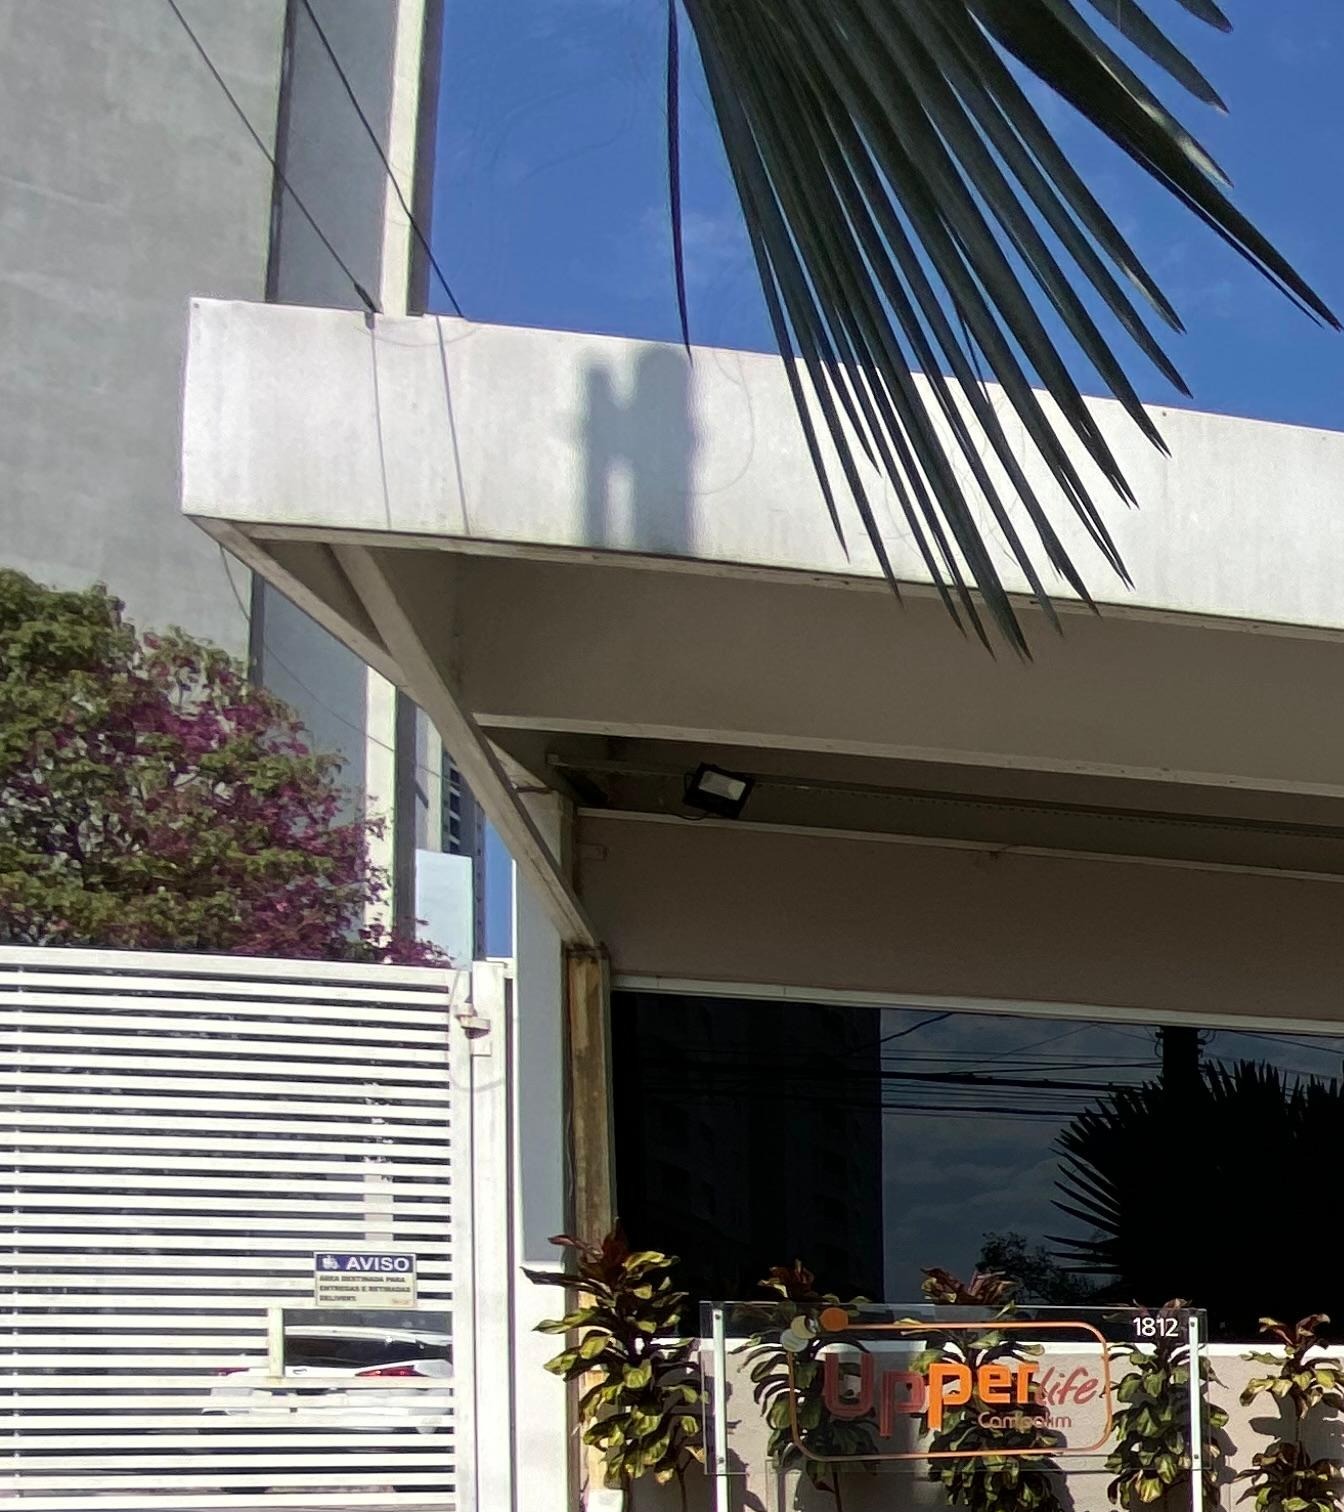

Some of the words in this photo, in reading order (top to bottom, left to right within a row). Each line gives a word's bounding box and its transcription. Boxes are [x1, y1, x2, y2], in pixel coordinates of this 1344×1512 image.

[346, 1256, 410, 1271] AVISO
[1132, 1316, 1179, 1338] 1812
[823, 1351, 1040, 1438] Upper
[1034, 1366, 1098, 1406] life
